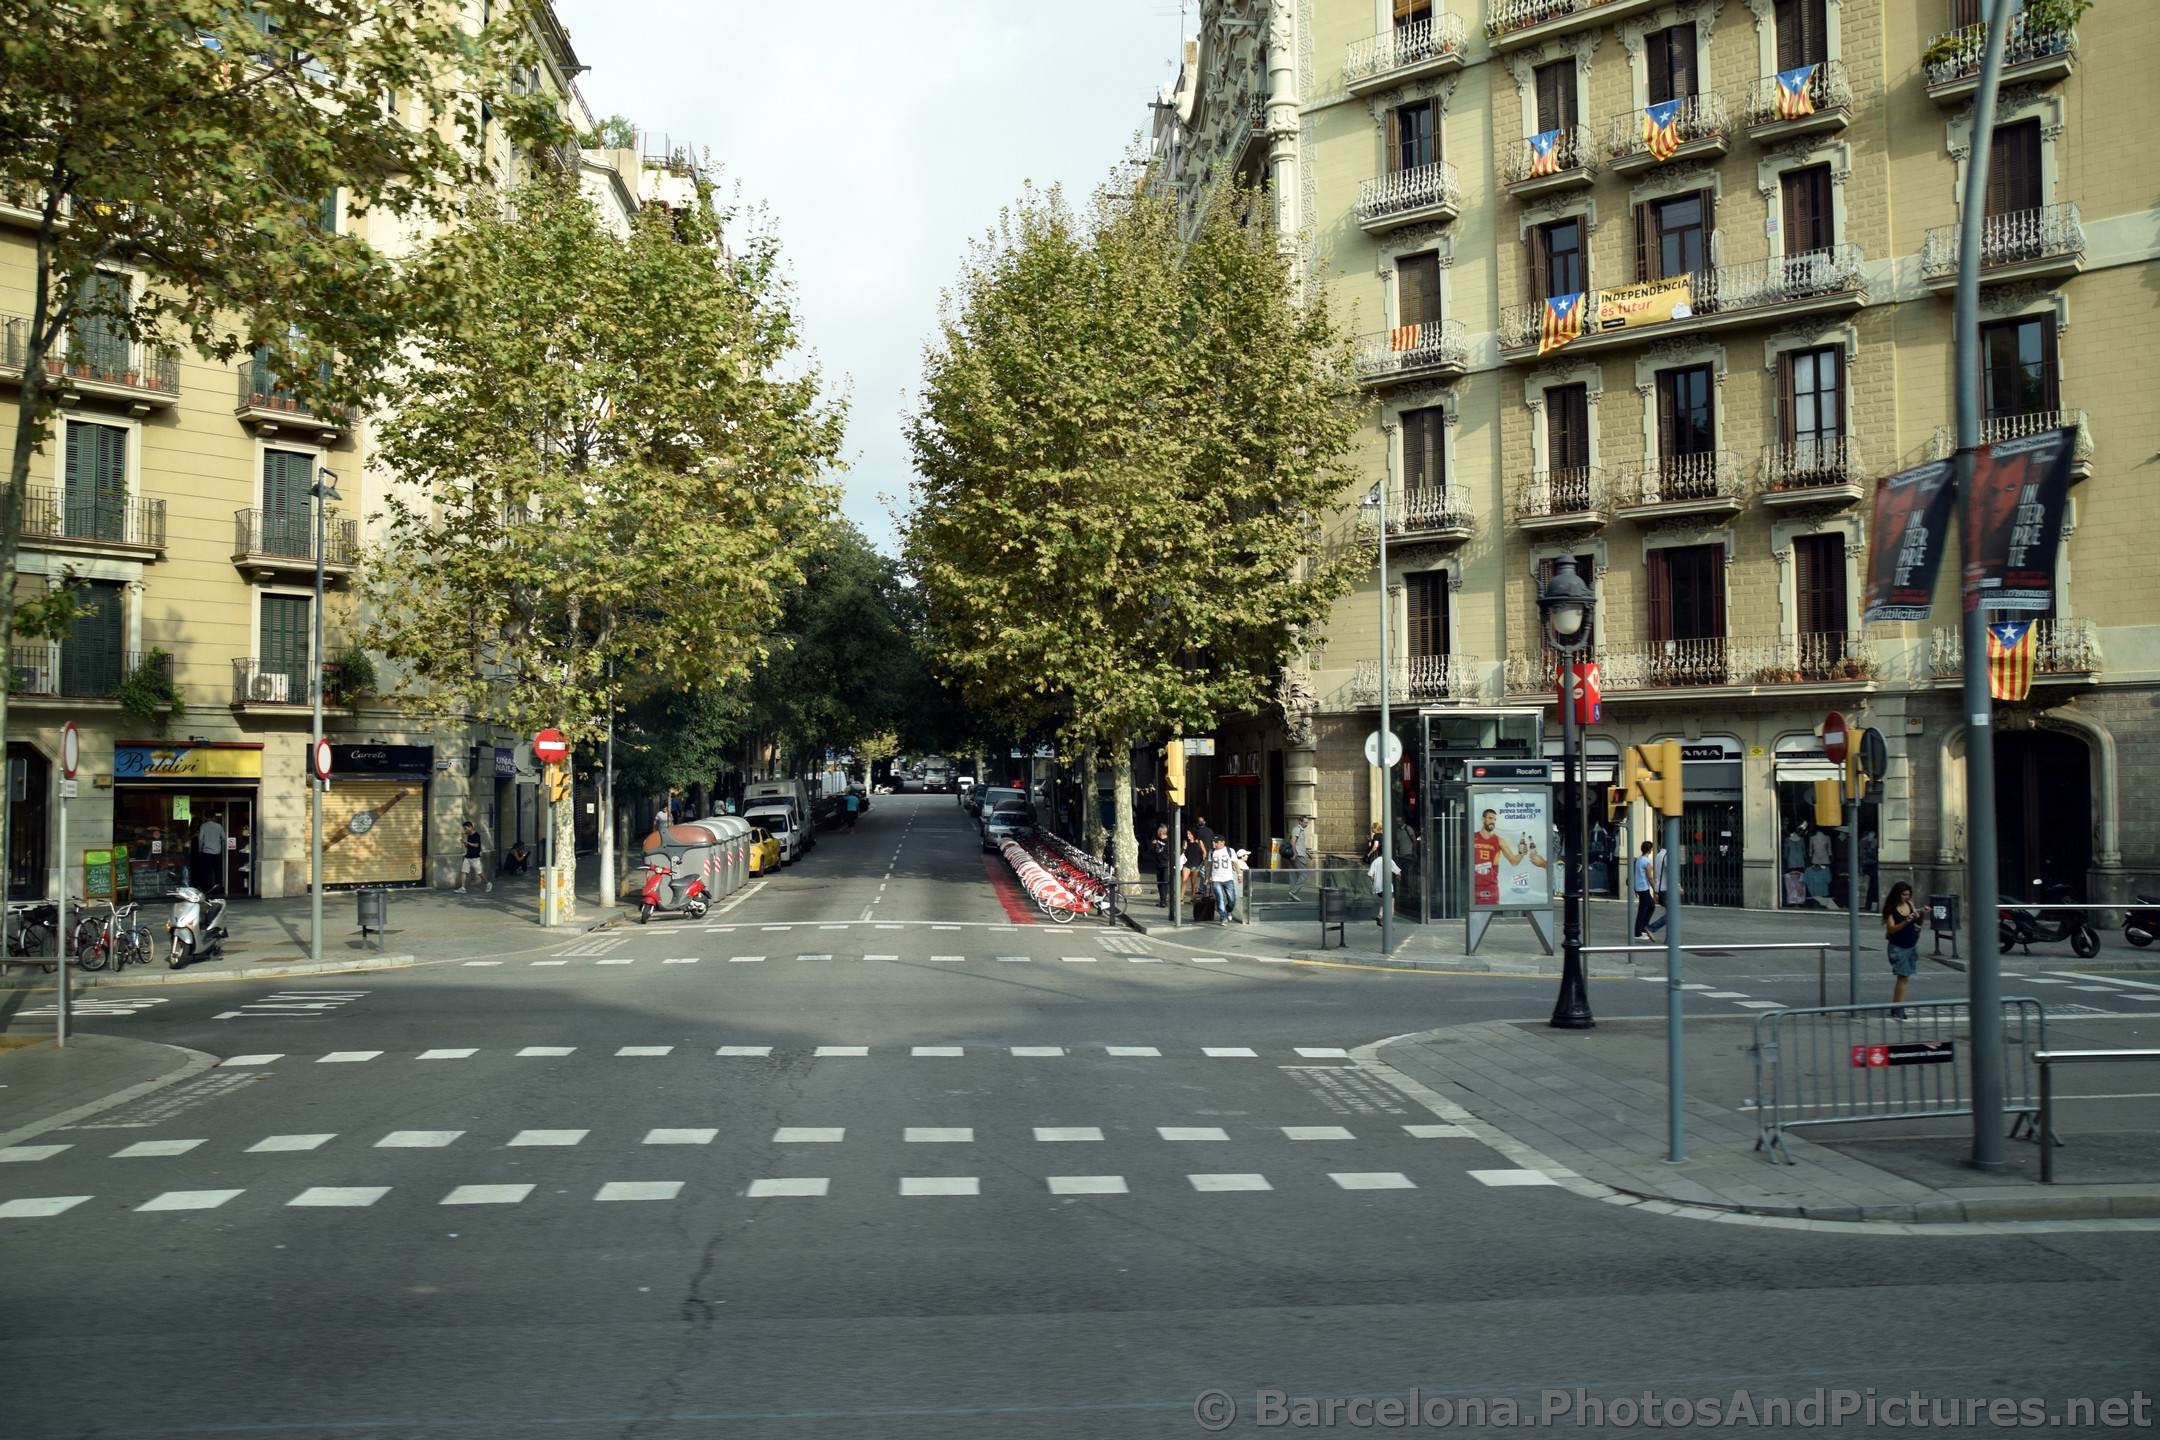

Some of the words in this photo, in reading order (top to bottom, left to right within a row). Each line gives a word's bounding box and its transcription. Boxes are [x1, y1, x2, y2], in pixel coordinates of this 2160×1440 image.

[1601, 279, 1689, 303] INDEPENDÈNCIA
[1601, 305, 1614, 317] és
[1618, 301, 1652, 314] futur
[116, 750, 199, 774] Baldiri
[495, 763, 516, 774] NAILS
